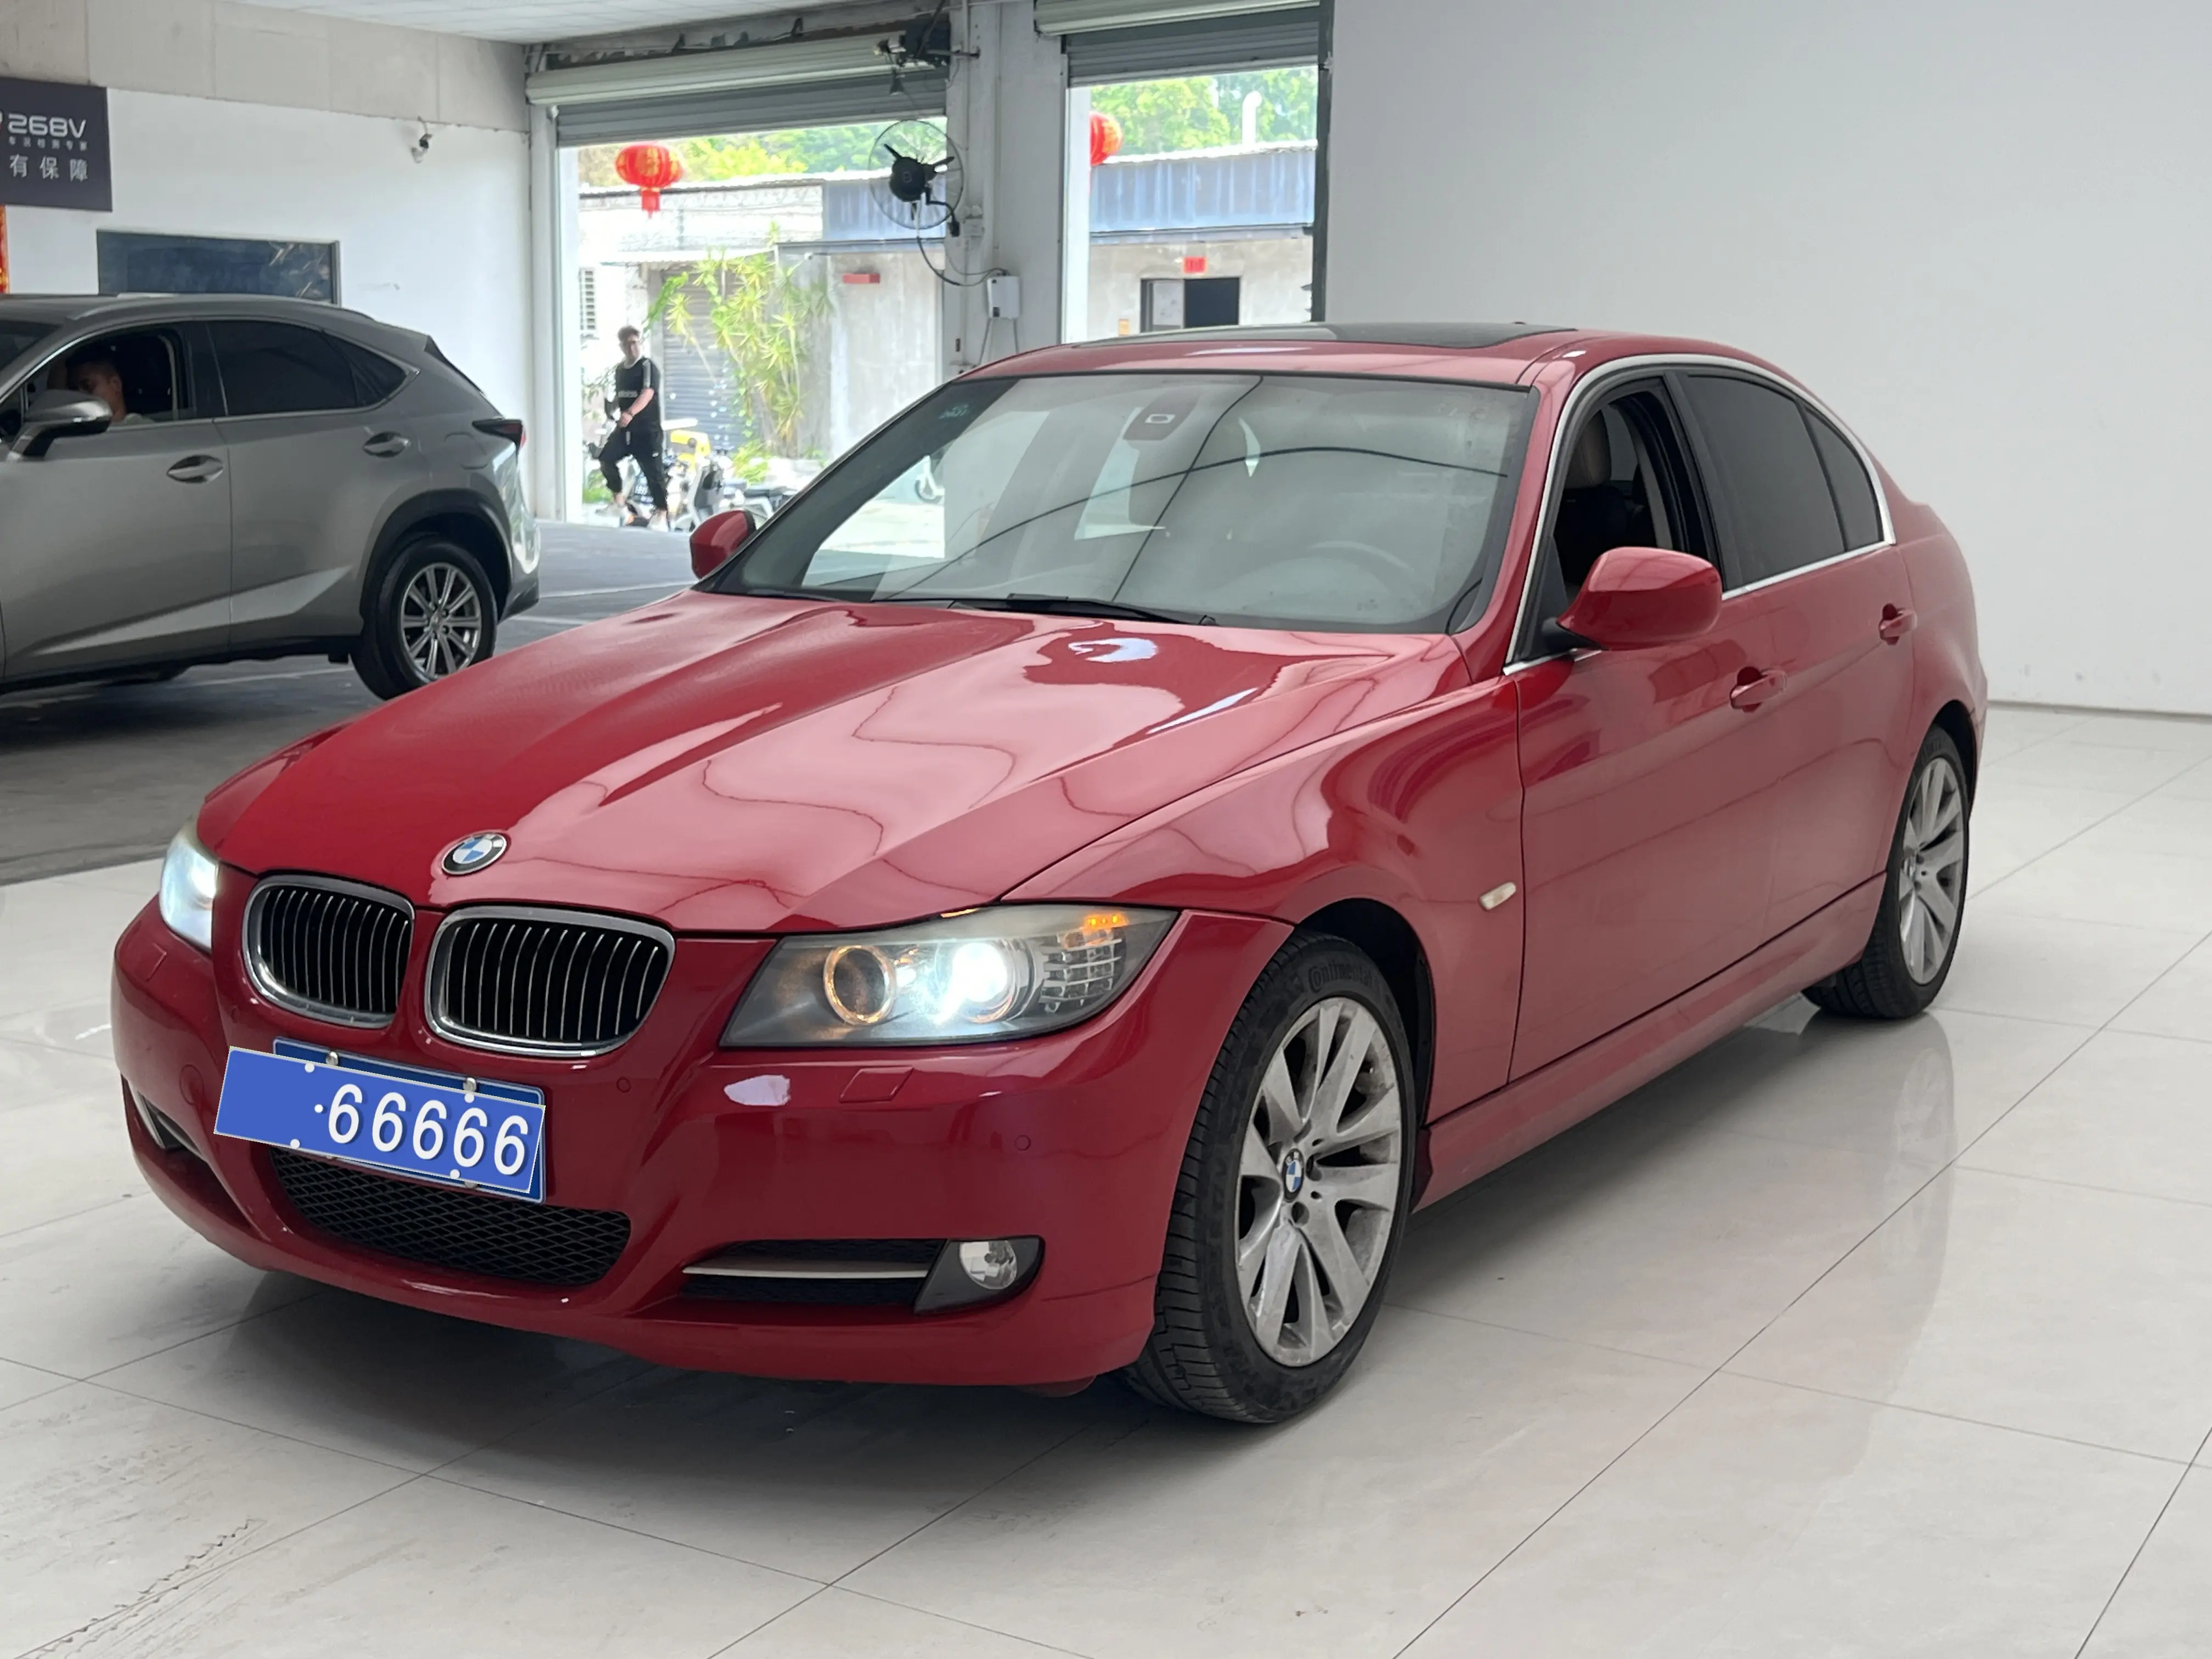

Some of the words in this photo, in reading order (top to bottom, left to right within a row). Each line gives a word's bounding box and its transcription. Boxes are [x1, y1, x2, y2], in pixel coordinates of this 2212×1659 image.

[8, 112, 87, 138] 268V
[9, 153, 88, 182] 有保障
